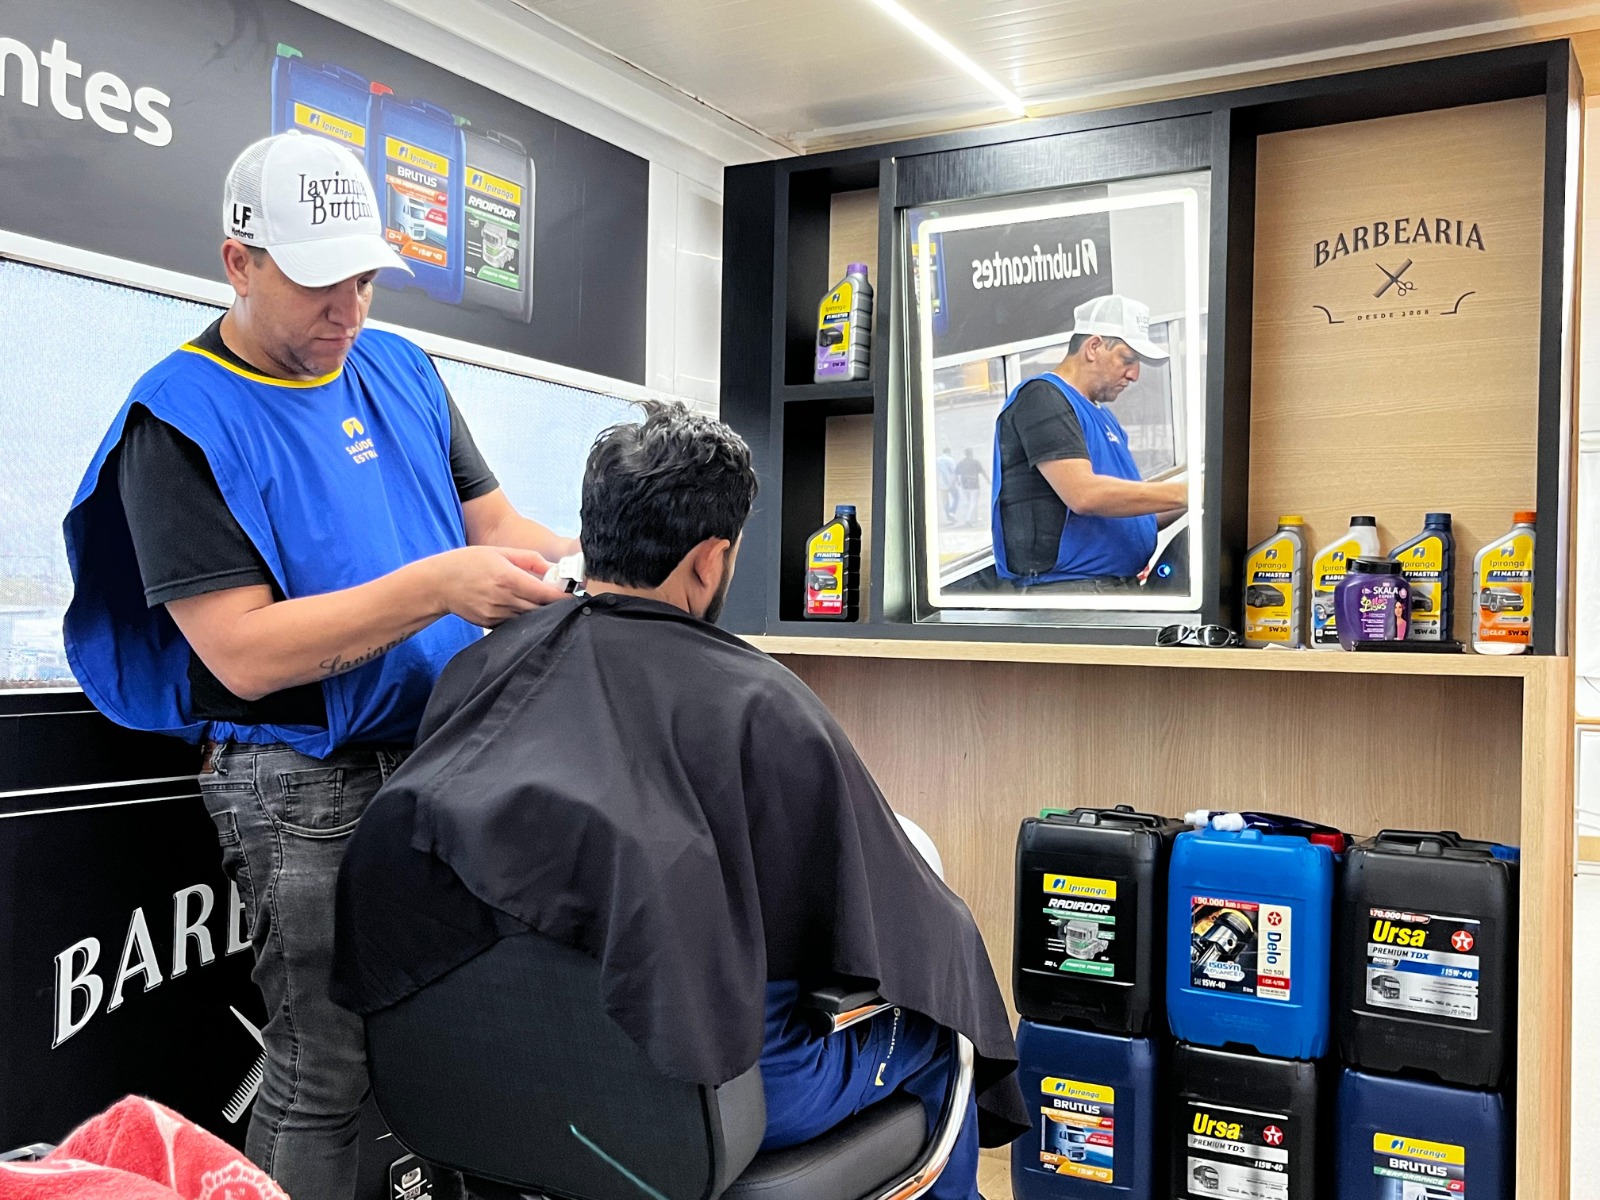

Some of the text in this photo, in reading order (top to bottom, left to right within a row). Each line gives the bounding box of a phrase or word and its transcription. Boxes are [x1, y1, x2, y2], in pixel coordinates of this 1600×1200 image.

[322, 120, 353, 138] Ipiranga
[410, 153, 437, 170] Ipiranga
[397, 165, 438, 188] BRUTUS
[484, 183, 514, 200] Ipiranga
[468, 195, 516, 220] RADIADOR
[233, 203, 252, 229] LF
[1313, 217, 1486, 269] BARBEARIA
[1357, 309, 1430, 321] DESDE 2008
[345, 438, 374, 455] SAÚDE
[1255, 562, 1287, 570] Ipiranga
[1322, 564, 1346, 573] Ipiran
[1402, 560, 1436, 568] Ipiranga
[1490, 560, 1525, 568] Ipiranga
[1373, 586, 1399, 595] SKALA
[1068, 883, 1107, 896] Ipiranga
[1048, 898, 1111, 914] RADIADOR
[1372, 920, 1426, 947] Ursa
[1266, 931, 1282, 965] Delo
[1373, 946, 1430, 960] PREMIUM TDX
[1445, 968, 1473, 979] 15W-40
[1202, 979, 1226, 989] 15W-40
[1068, 1087, 1100, 1099] Ipiranga
[1053, 1098, 1100, 1115] BRUTUS
[1192, 1112, 1241, 1140] Ursa
[1193, 1138, 1246, 1153] PREMIUM TDS
[1407, 1145, 1447, 1159] Ipiranga
[1259, 1160, 1284, 1172] 15W-40
[1389, 1157, 1448, 1177] BRUTUS
[1380, 1168, 1445, 1186] PERFORMANCE
